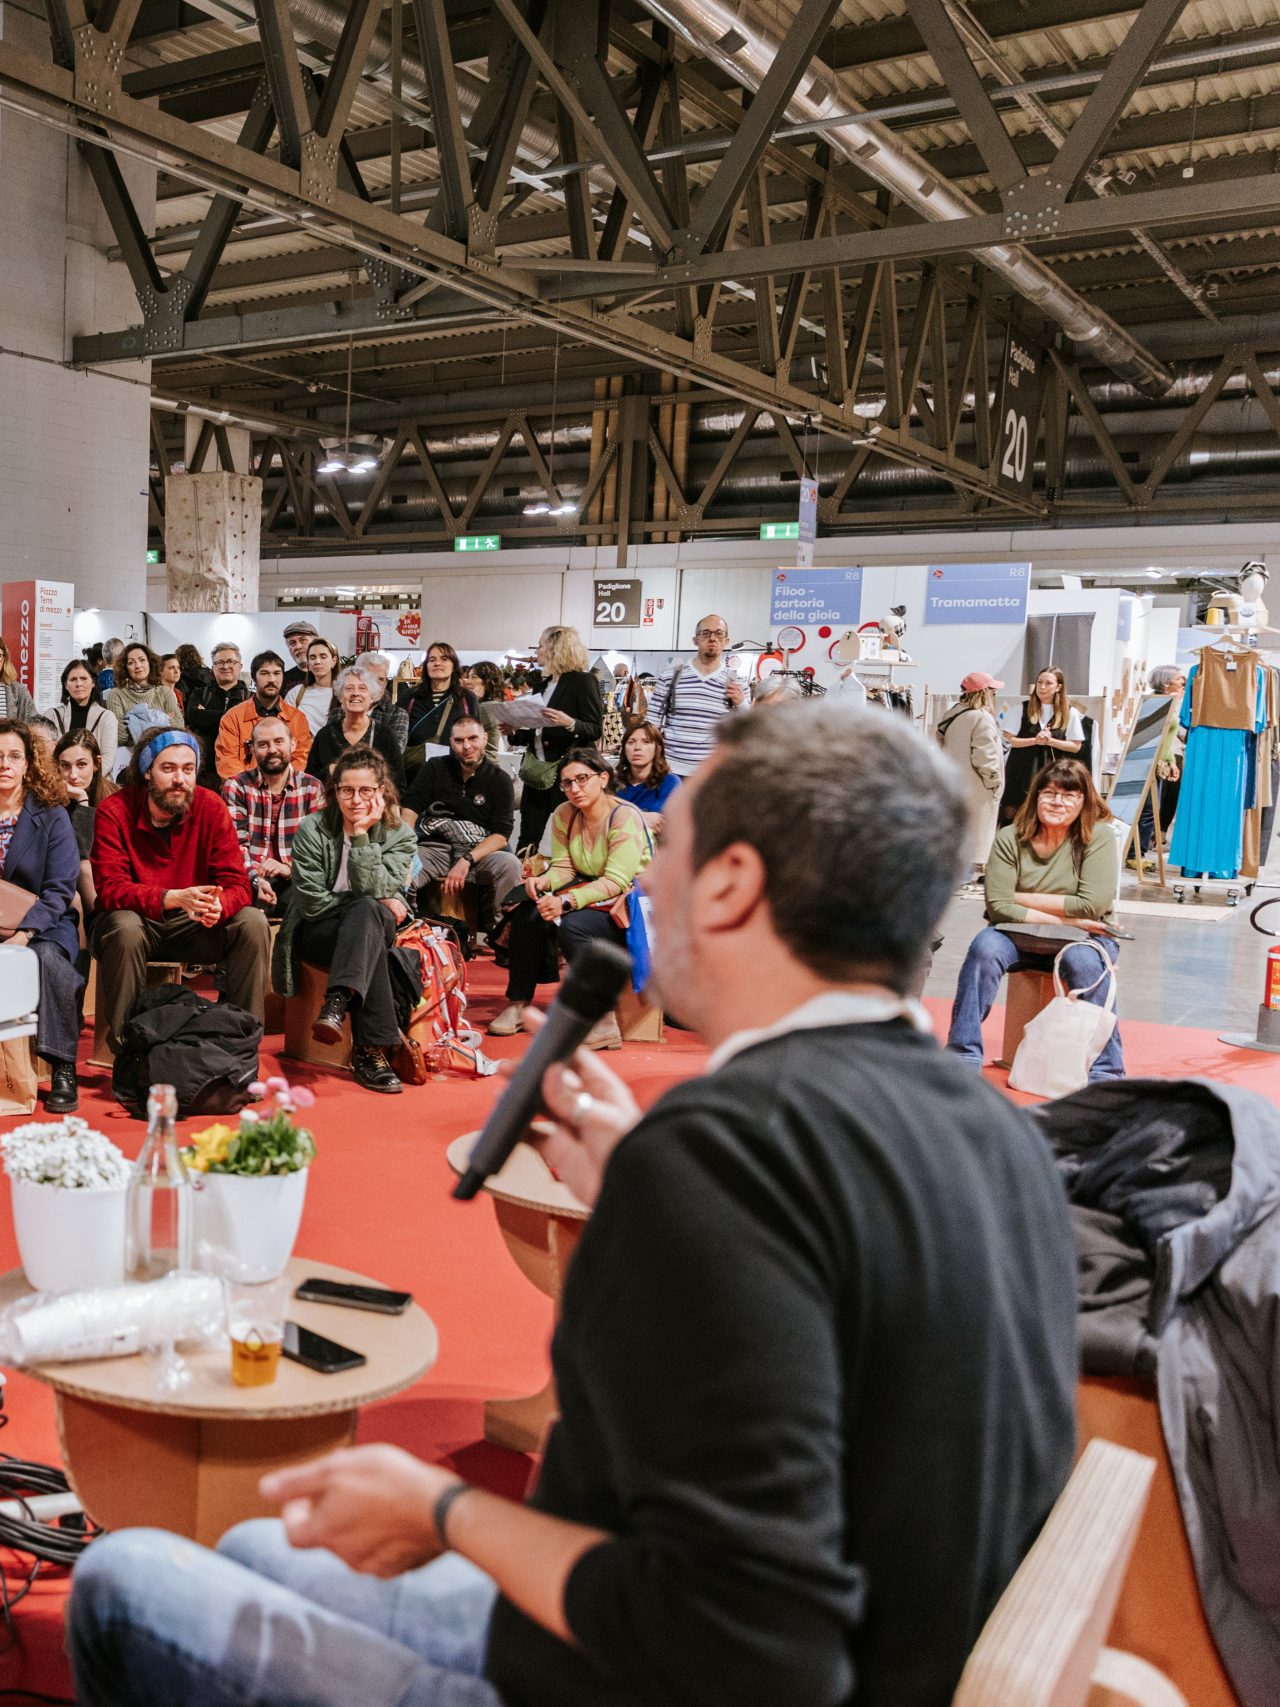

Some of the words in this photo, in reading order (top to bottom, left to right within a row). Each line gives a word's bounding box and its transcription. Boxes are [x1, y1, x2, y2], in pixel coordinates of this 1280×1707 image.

[1002, 408, 1028, 482] 20
[845, 572, 860, 581] R8
[1009, 568, 1025, 577] R8
[775, 586, 806, 596] Filoo
[774, 598, 825, 609] sartoria
[930, 597, 1020, 608] Tramamatta
[595, 602, 626, 622] 20
[773, 610, 806, 620] della
[807, 610, 840, 623] gioia
